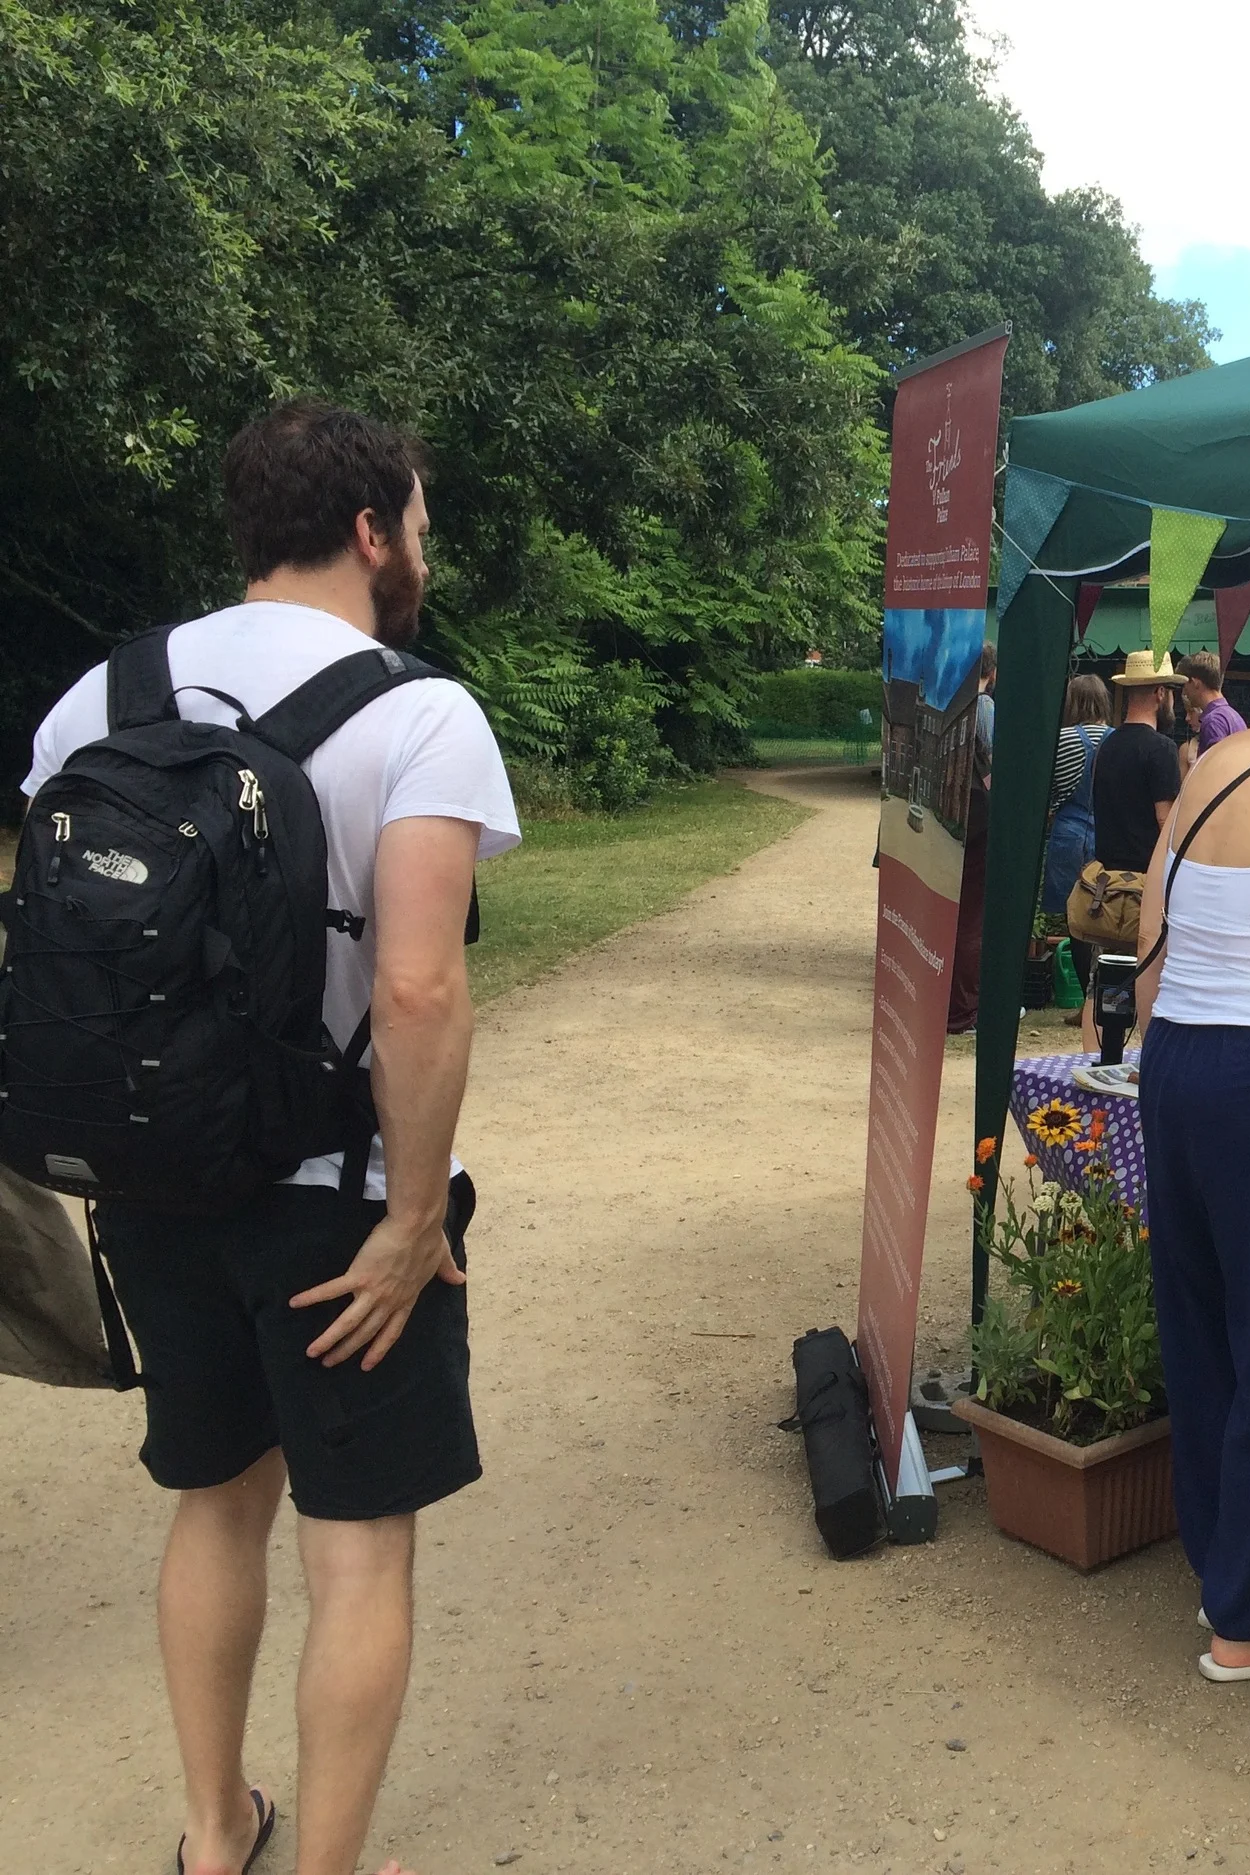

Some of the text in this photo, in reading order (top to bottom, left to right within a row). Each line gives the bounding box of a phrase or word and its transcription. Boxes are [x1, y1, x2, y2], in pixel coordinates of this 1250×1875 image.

[82, 849, 130, 874] NORTH
[107, 848, 133, 866] THE
[88, 862, 121, 880] FACE
